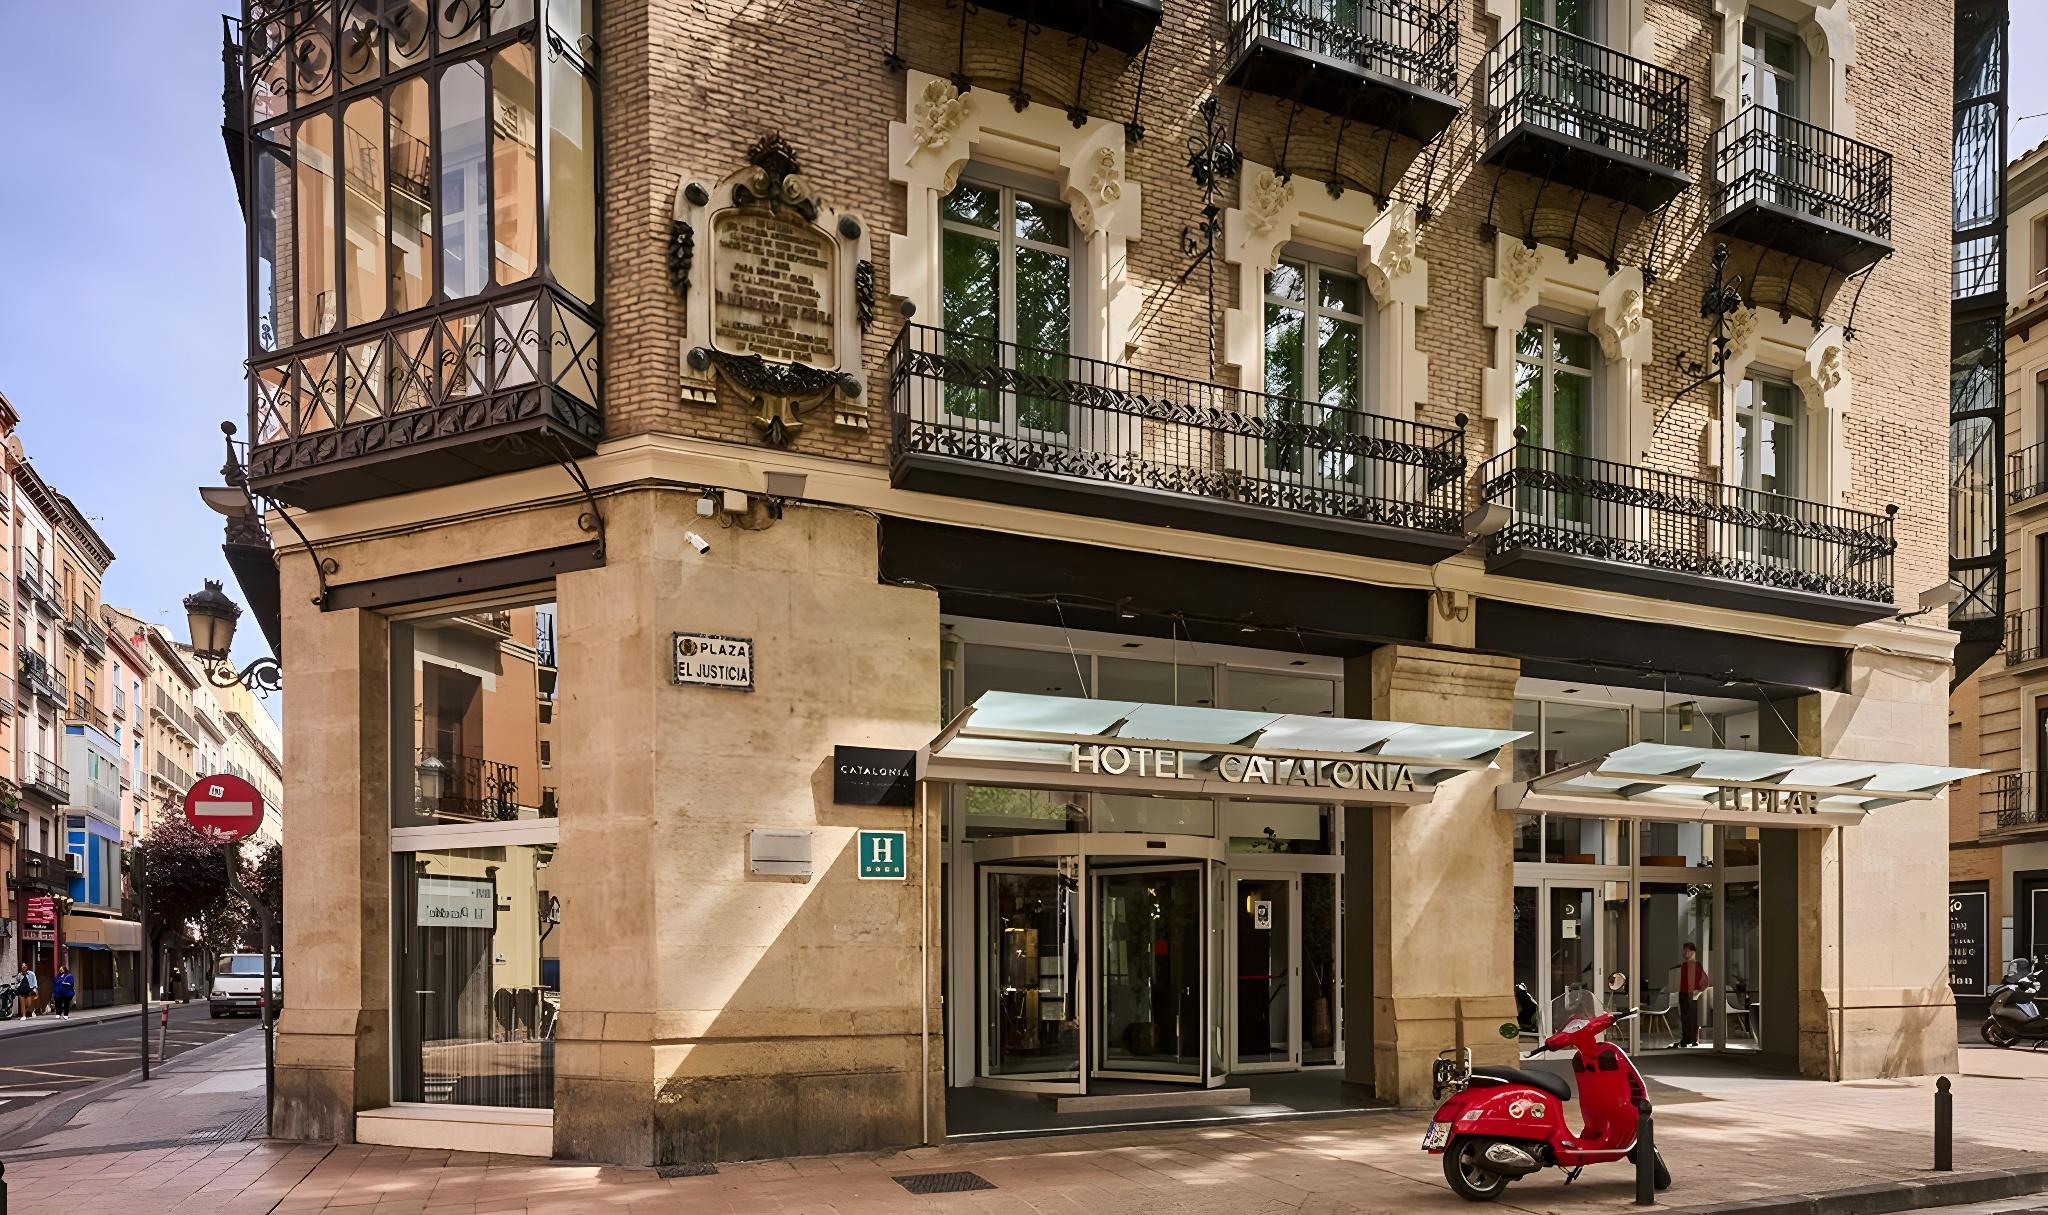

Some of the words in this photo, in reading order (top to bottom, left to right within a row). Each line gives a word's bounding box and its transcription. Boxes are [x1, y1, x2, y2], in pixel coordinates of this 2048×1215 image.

[700, 642, 746, 657] PLAZA
[678, 661, 692, 676] EL
[697, 663, 748, 681] JUSTICIA
[840, 765, 909, 777] CATALONIA
[1071, 743, 1194, 779] HOTEL
[1219, 753, 1415, 792] CATALONIA
[1719, 786, 1749, 811] EL
[1752, 788, 1819, 814] PILAR
[872, 837, 893, 863] H
